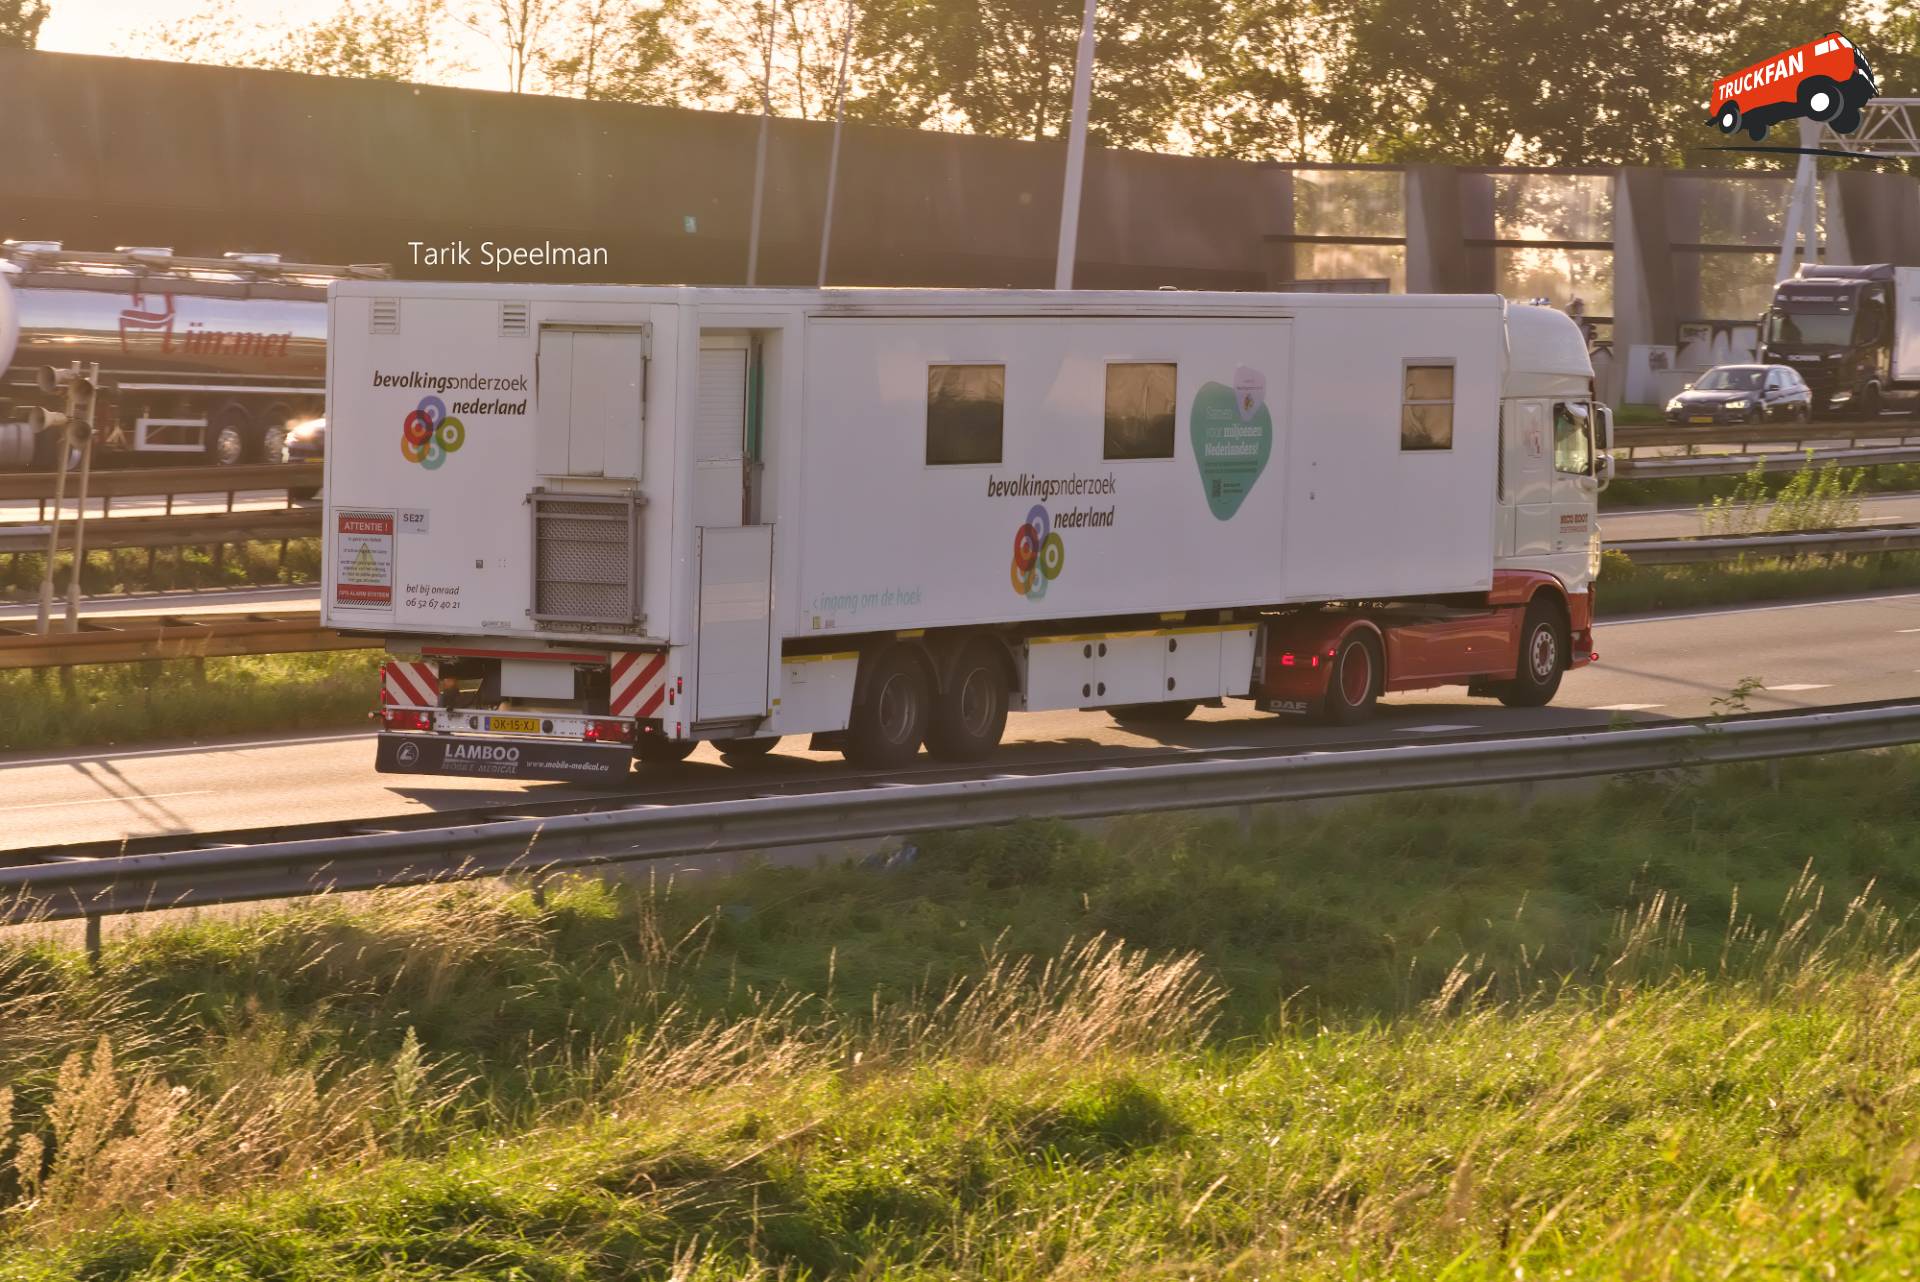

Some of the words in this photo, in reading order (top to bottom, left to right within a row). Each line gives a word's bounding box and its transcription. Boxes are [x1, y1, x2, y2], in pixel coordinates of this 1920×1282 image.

[452, 398, 527, 416] nederland
[403, 513, 424, 523] SE27
[1053, 505, 1115, 529] nederland
[344, 521, 384, 532] ATTENTIE
[406, 583, 418, 593] bel
[431, 585, 460, 596] onraad
[405, 597, 417, 607] 06
[418, 600, 427, 609] 52
[428, 598, 439, 610] 67
[1269, 700, 1308, 710] DAF
[444, 743, 520, 761] LAMBOO
